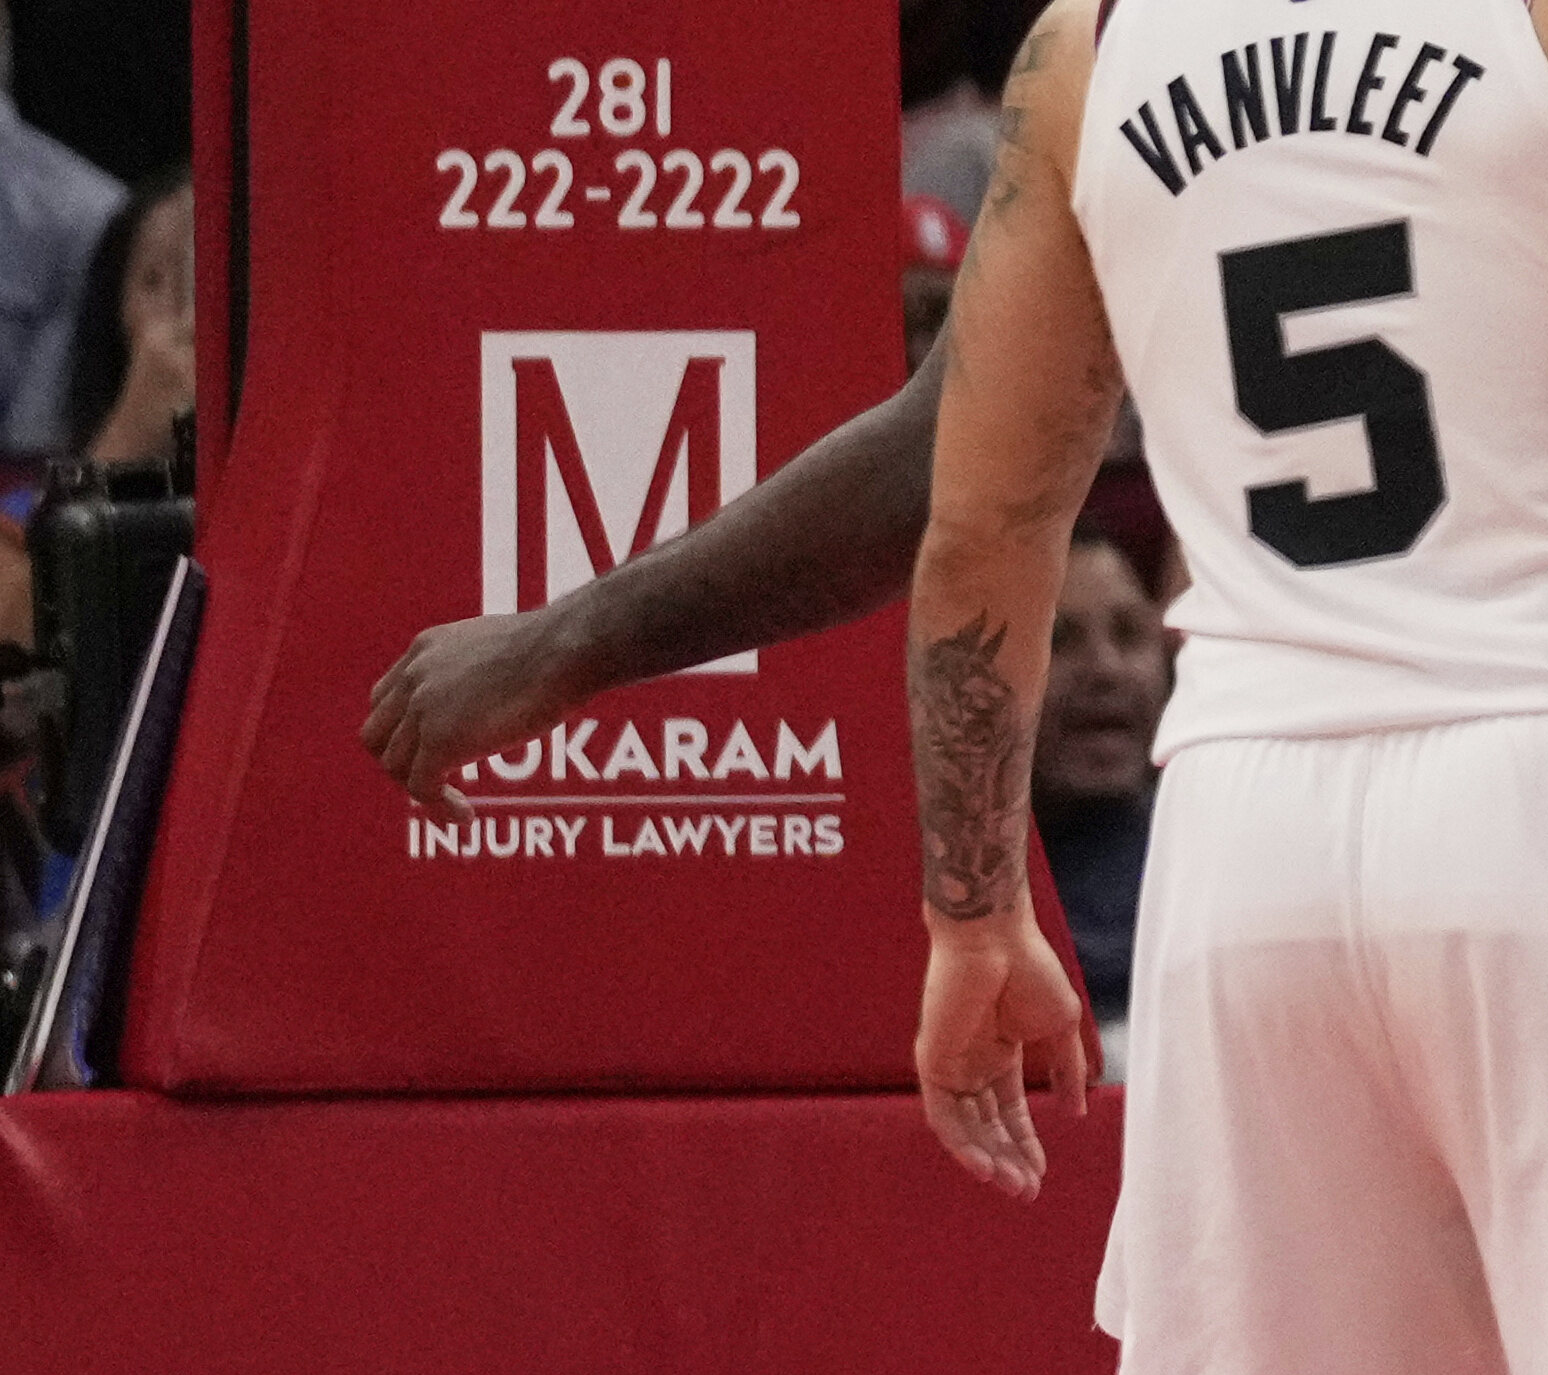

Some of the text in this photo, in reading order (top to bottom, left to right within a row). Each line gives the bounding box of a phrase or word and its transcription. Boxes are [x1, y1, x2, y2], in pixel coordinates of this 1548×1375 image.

[548, 58, 671, 136] 281
[1119, 31, 1487, 197] VANVLEET
[436, 149, 800, 228] 222-2222
[1218, 218, 1450, 571] 5
[460, 718, 842, 781] OKARAM
[409, 815, 845, 859] INJURY LAWYERS
